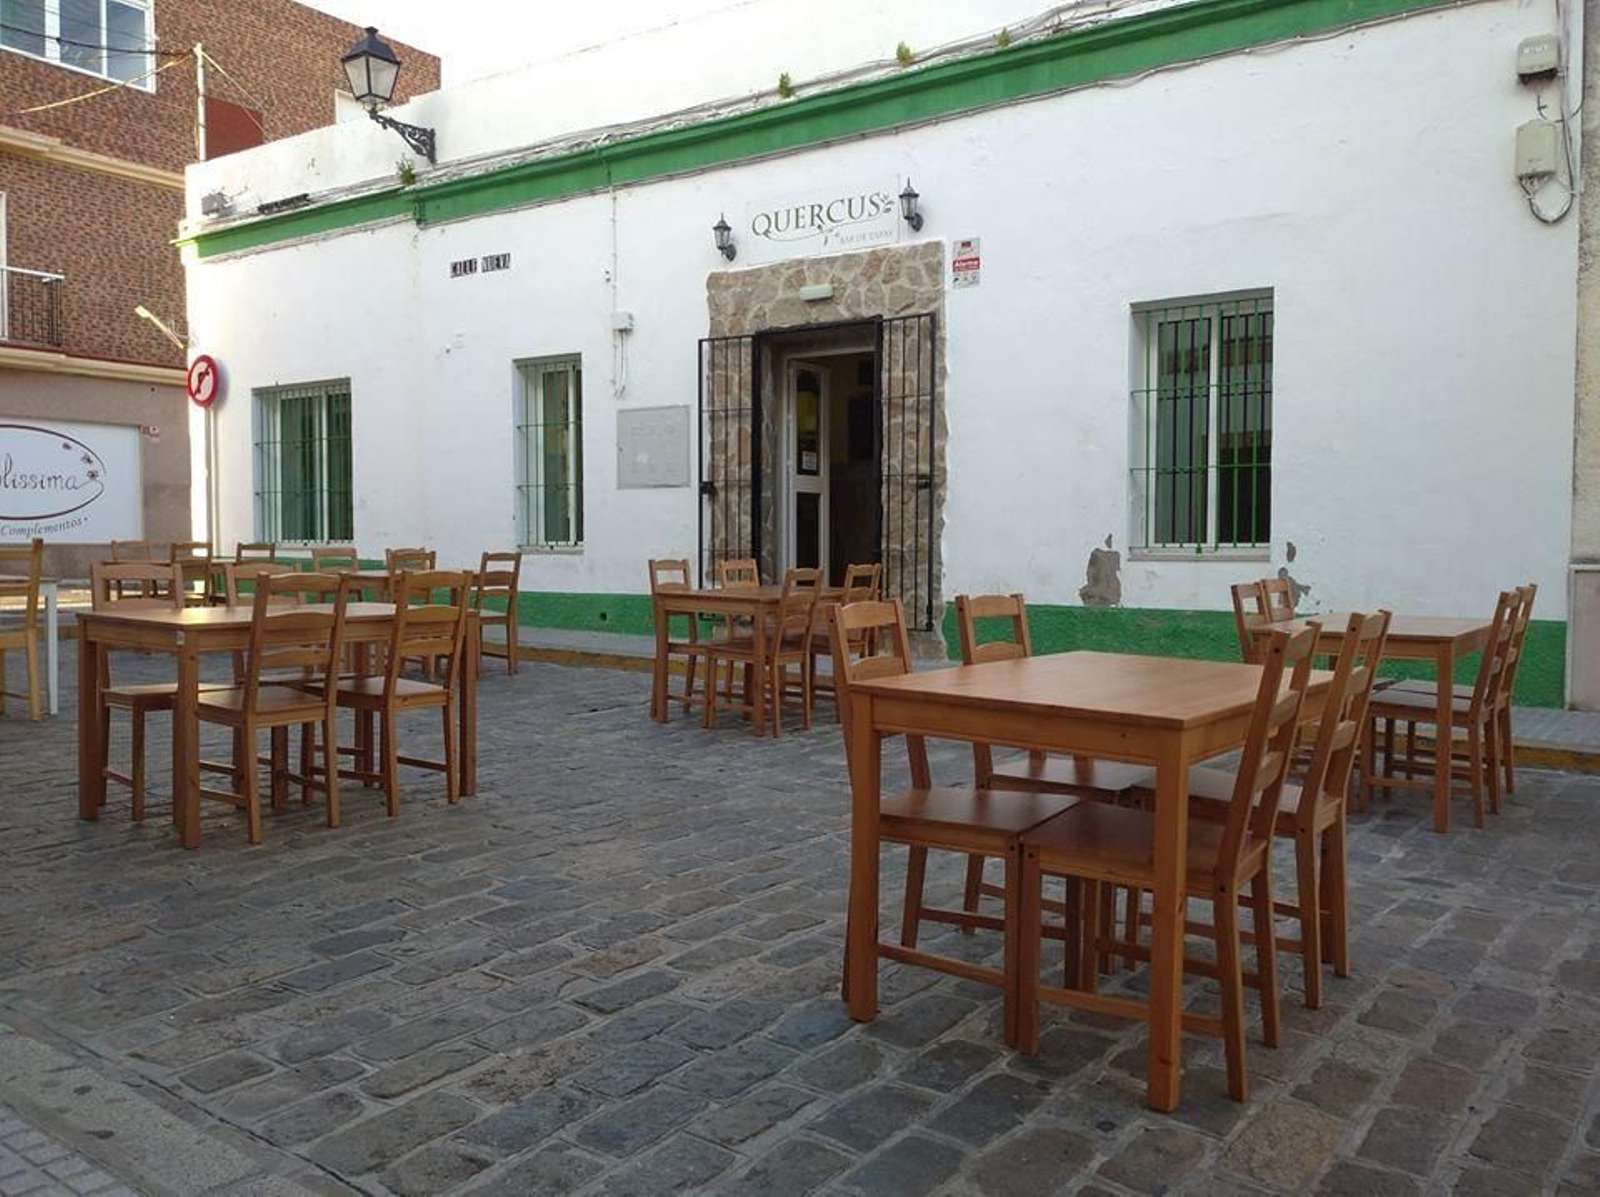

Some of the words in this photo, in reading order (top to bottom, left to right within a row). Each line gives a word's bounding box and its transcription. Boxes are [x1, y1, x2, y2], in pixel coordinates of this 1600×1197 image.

[752, 192, 881, 239] QUERCUS
[451, 258, 477, 278] CALLE
[482, 253, 510, 272] NUEVA
[0, 453, 79, 490] lissima
[1, 517, 82, 538] Complementos
